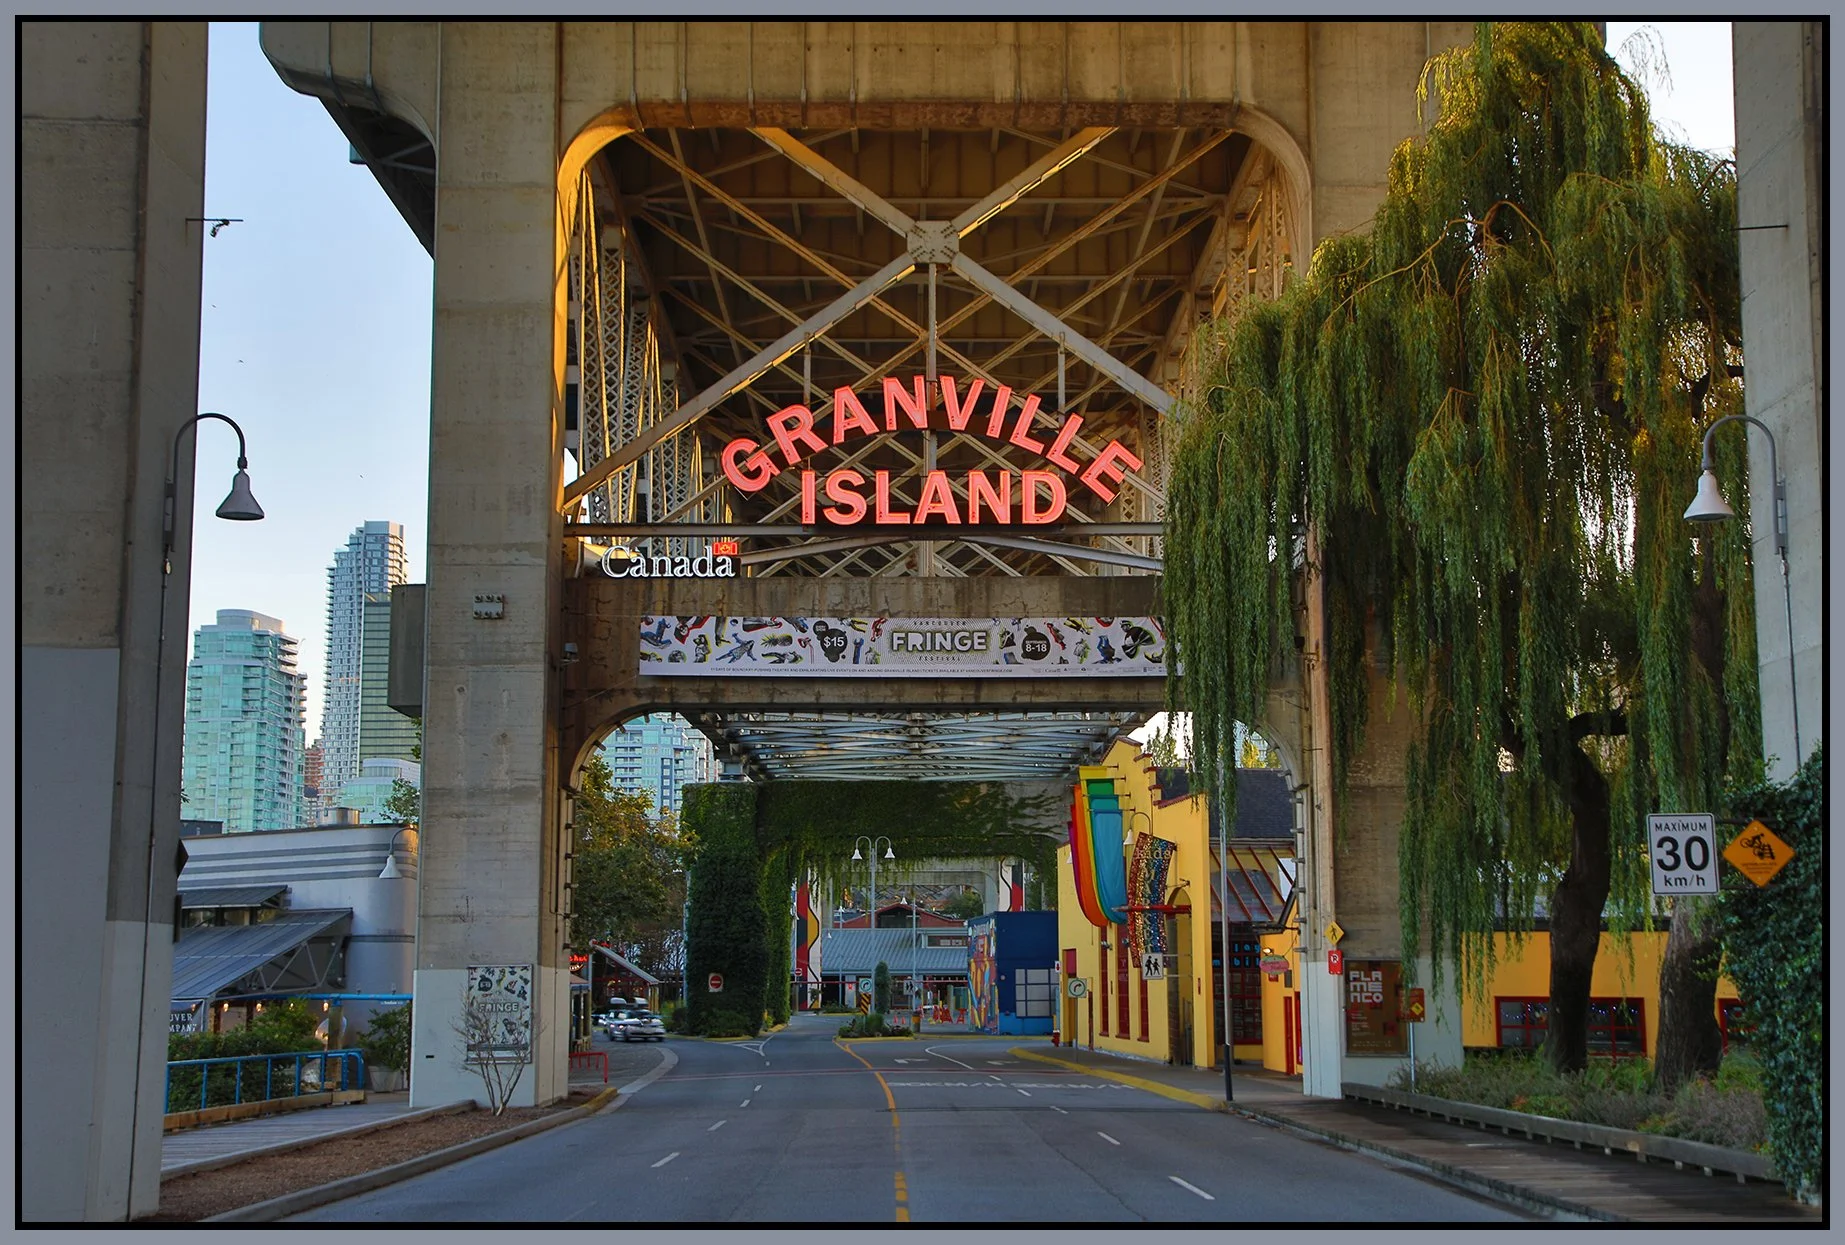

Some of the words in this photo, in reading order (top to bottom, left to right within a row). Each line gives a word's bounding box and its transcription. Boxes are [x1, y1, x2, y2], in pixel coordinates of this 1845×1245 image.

[720, 375, 1144, 505] GRANVILLE
[801, 469, 1067, 526] ISLAND
[601, 545, 736, 578] Canada
[913, 619, 966, 627] VANCOUVER
[823, 636, 844, 649] $15
[892, 630, 988, 652] FRINGE
[1025, 643, 1047, 653] 8-18
[1654, 822, 1708, 832] MAXIMUM
[1656, 835, 1710, 872] 30
[1663, 874, 1706, 887] km/h
[479, 1002, 518, 1012] FRINGE
